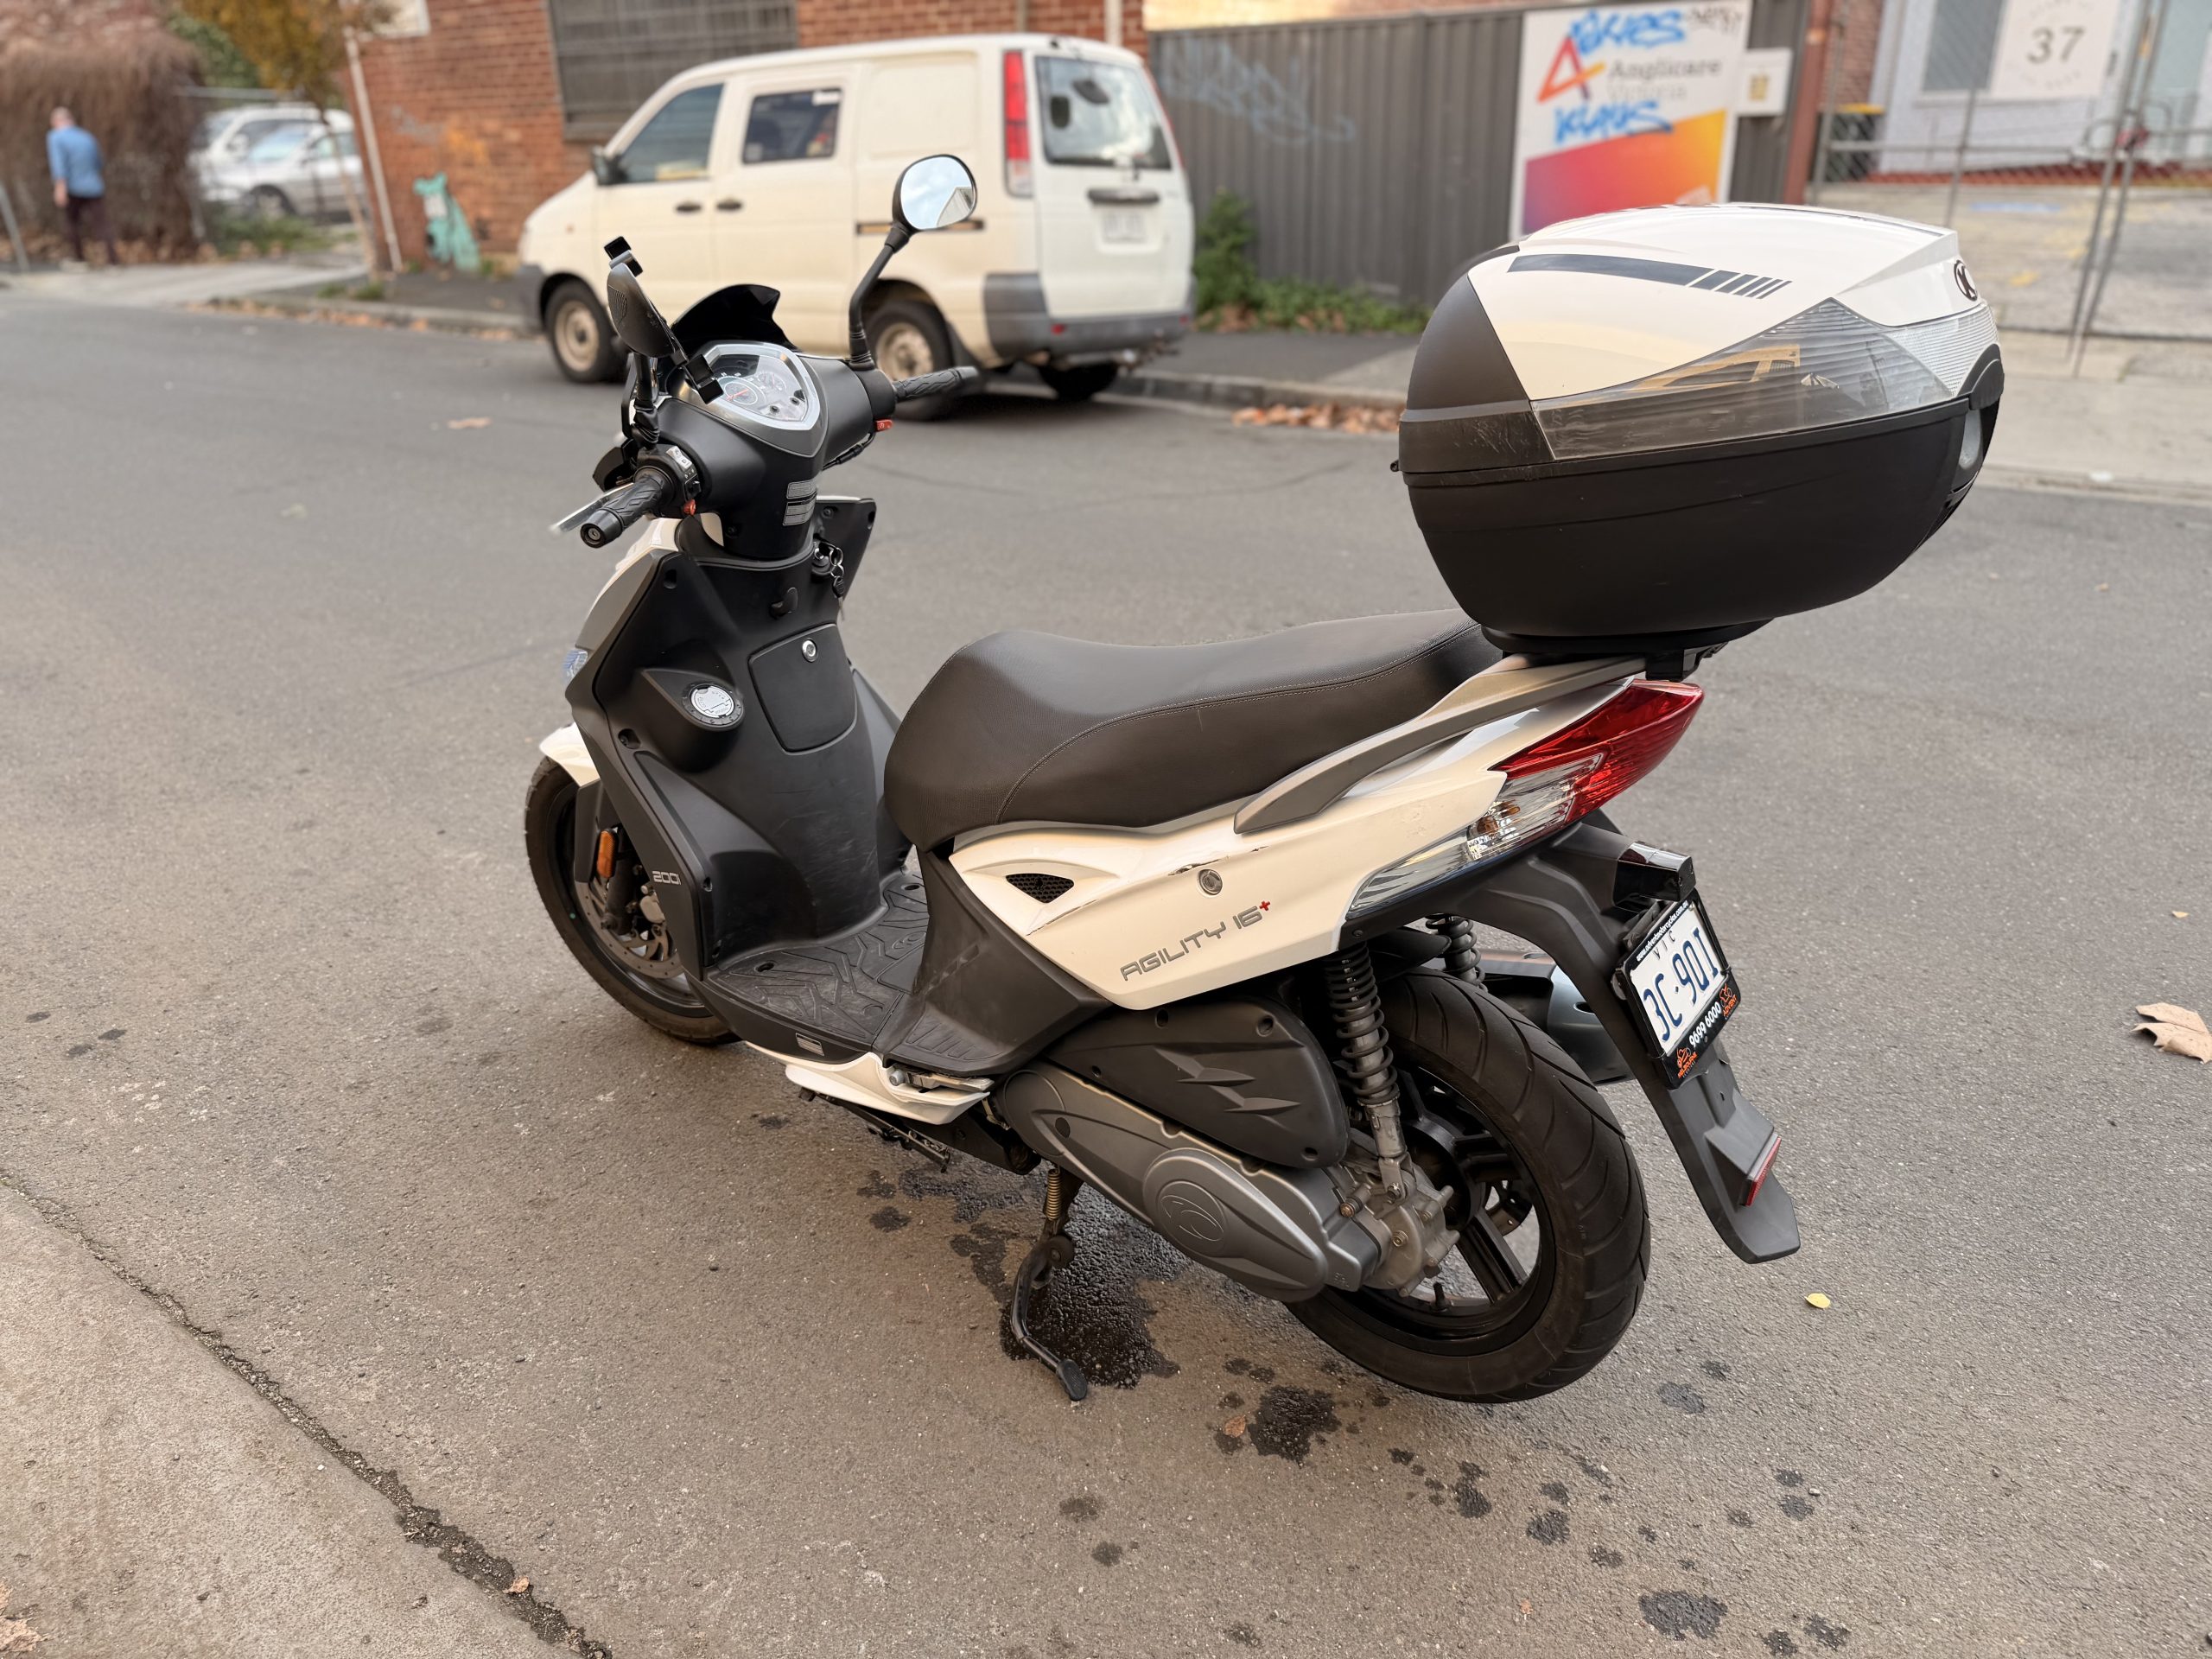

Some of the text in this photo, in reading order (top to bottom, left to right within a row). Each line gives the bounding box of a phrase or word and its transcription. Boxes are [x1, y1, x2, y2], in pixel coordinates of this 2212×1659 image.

[2028, 26, 2086, 64] 37
[1610, 59, 1722, 80] Anglicare
[1120, 921, 1227, 982] AGILITY
[1652, 930, 1676, 961] VIC
[1688, 1021, 1707, 1048] 9699
[1704, 1001, 1722, 1028] 6000
